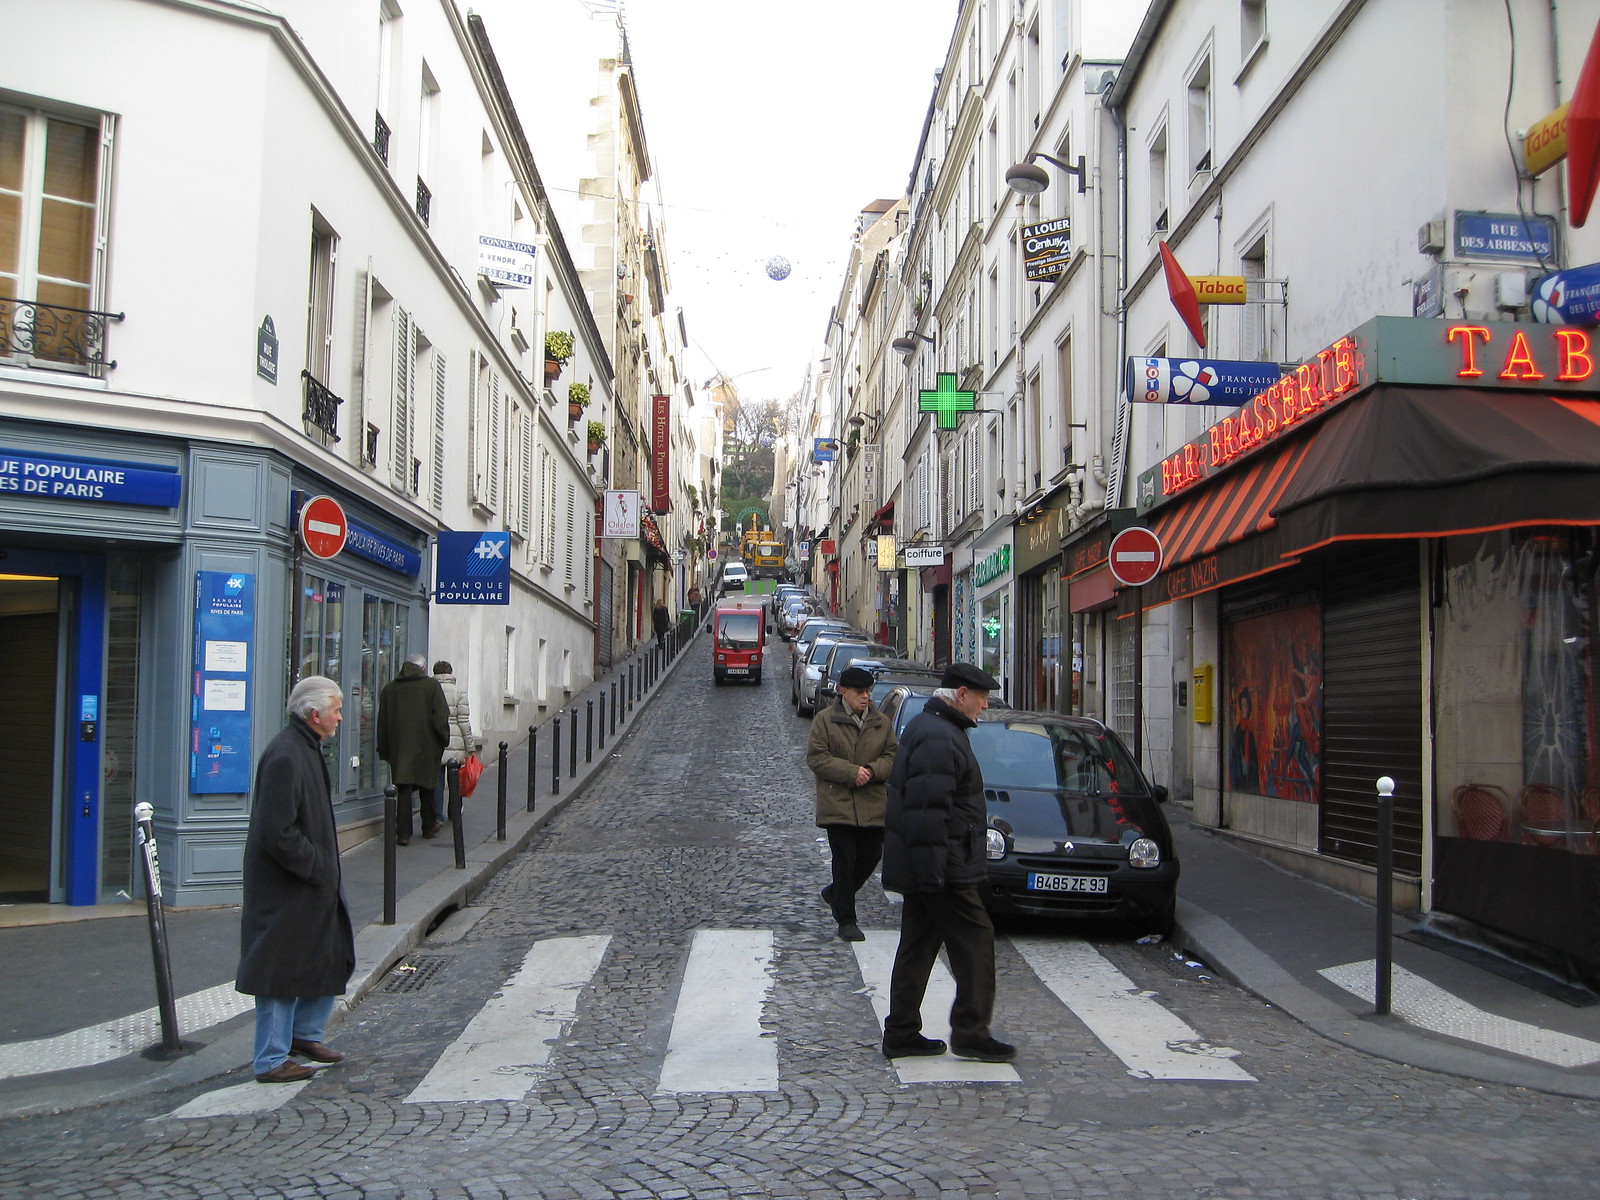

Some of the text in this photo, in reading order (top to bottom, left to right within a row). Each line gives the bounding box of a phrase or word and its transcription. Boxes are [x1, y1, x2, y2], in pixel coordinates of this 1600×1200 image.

[1024, 219, 1070, 238] A LOUER
[1490, 223, 1518, 236] RUE
[480, 236, 533, 252] CONNEXION
[1026, 236, 1064, 253] Century
[1460, 237, 1548, 254] DES ABBESSES
[487, 254, 517, 265] VENDRE
[487, 268, 497, 277] 53
[498, 270, 508, 278] 09
[509, 273, 519, 281] 24
[520, 275, 530, 284] 34
[1196, 280, 1244, 294] Tabac
[1569, 303, 1585, 314] DES
[263, 342, 273, 358] RUE
[1447, 326, 1594, 381] TAB
[1145, 358, 1160, 402] LOTO
[1225, 386, 1243, 395] DES
[1161, 337, 1355, 497] BAR BRASSERIE
[24, 462, 125, 485] POPULAIRE
[24, 479, 49, 494] DE
[53, 481, 104, 498] PARIS
[906, 548, 942, 559] coiffure
[1190, 556, 1219, 589] NAZIR
[439, 581, 503, 590] BANQUE
[439, 592, 503, 600] POPULAIRE
[1036, 875, 1106, 892] 8485 ZE 93
